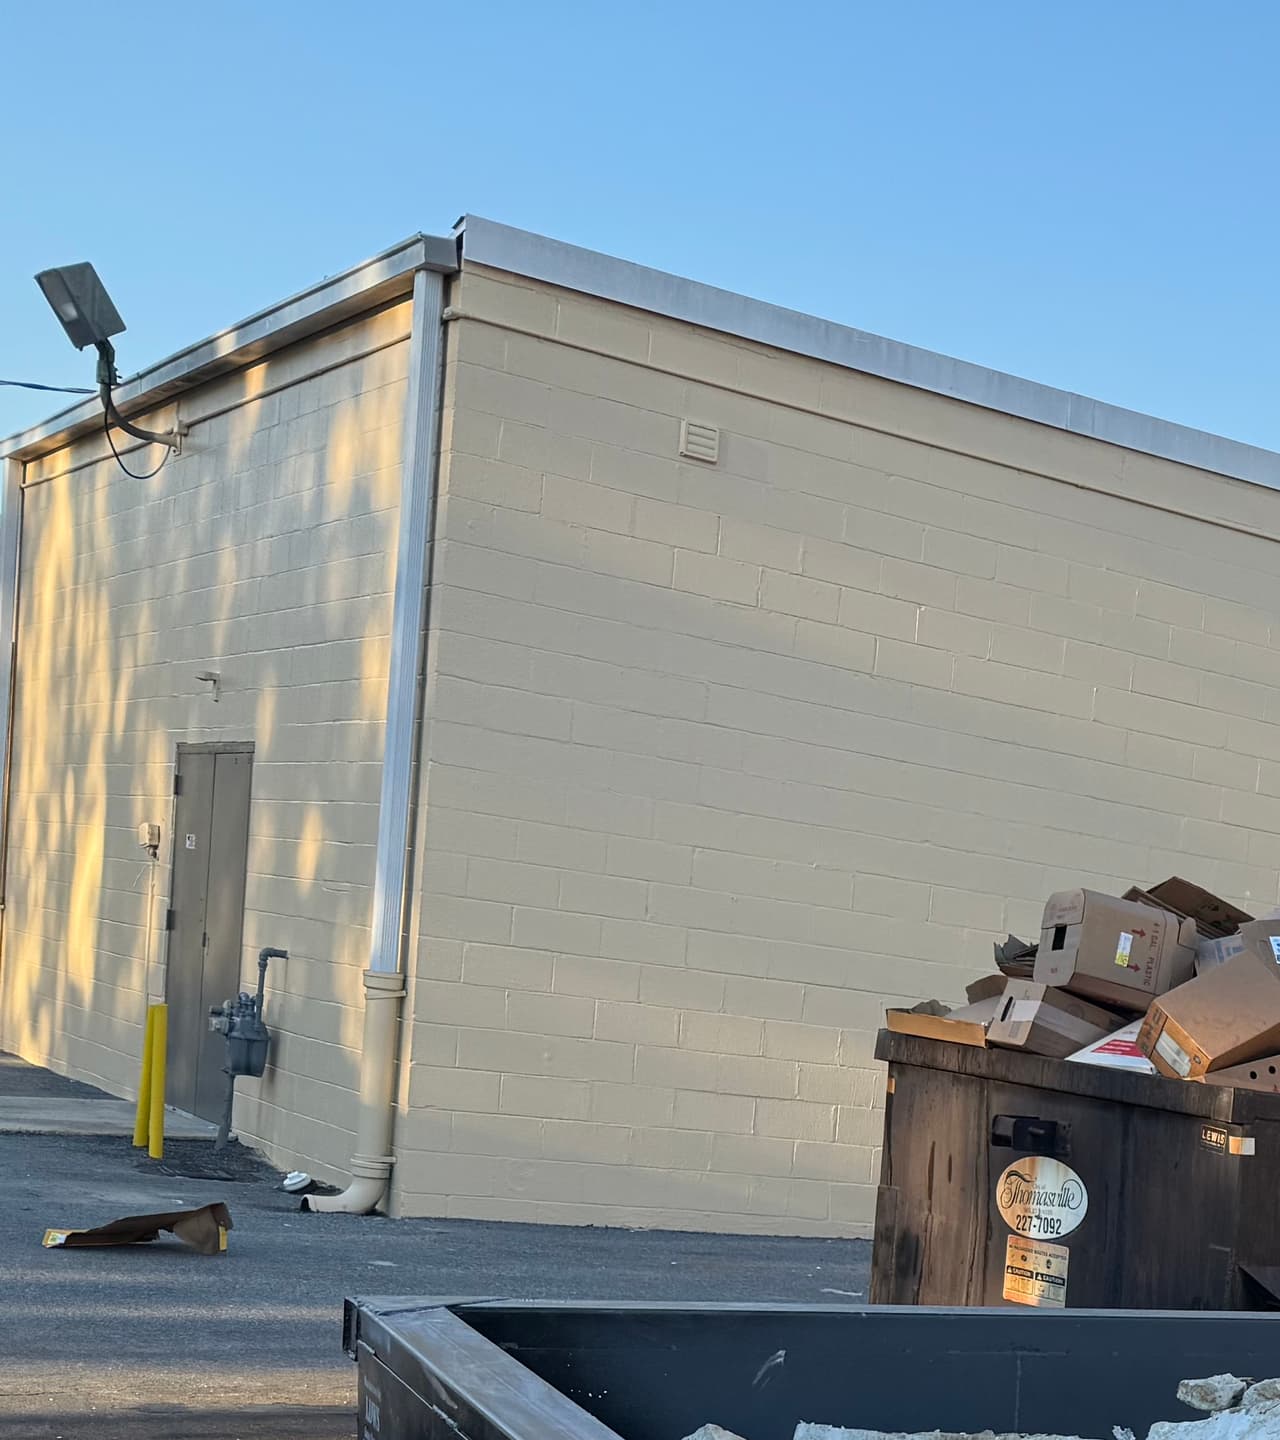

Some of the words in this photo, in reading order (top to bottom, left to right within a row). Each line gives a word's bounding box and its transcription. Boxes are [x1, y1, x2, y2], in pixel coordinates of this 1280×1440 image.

[1143, 957, 1154, 986] PLASTIC
[1202, 1129, 1225, 1145] LEWIS
[1000, 1170, 1083, 1209] Thomasville
[1016, 1214, 1062, 1235] 227-7092
